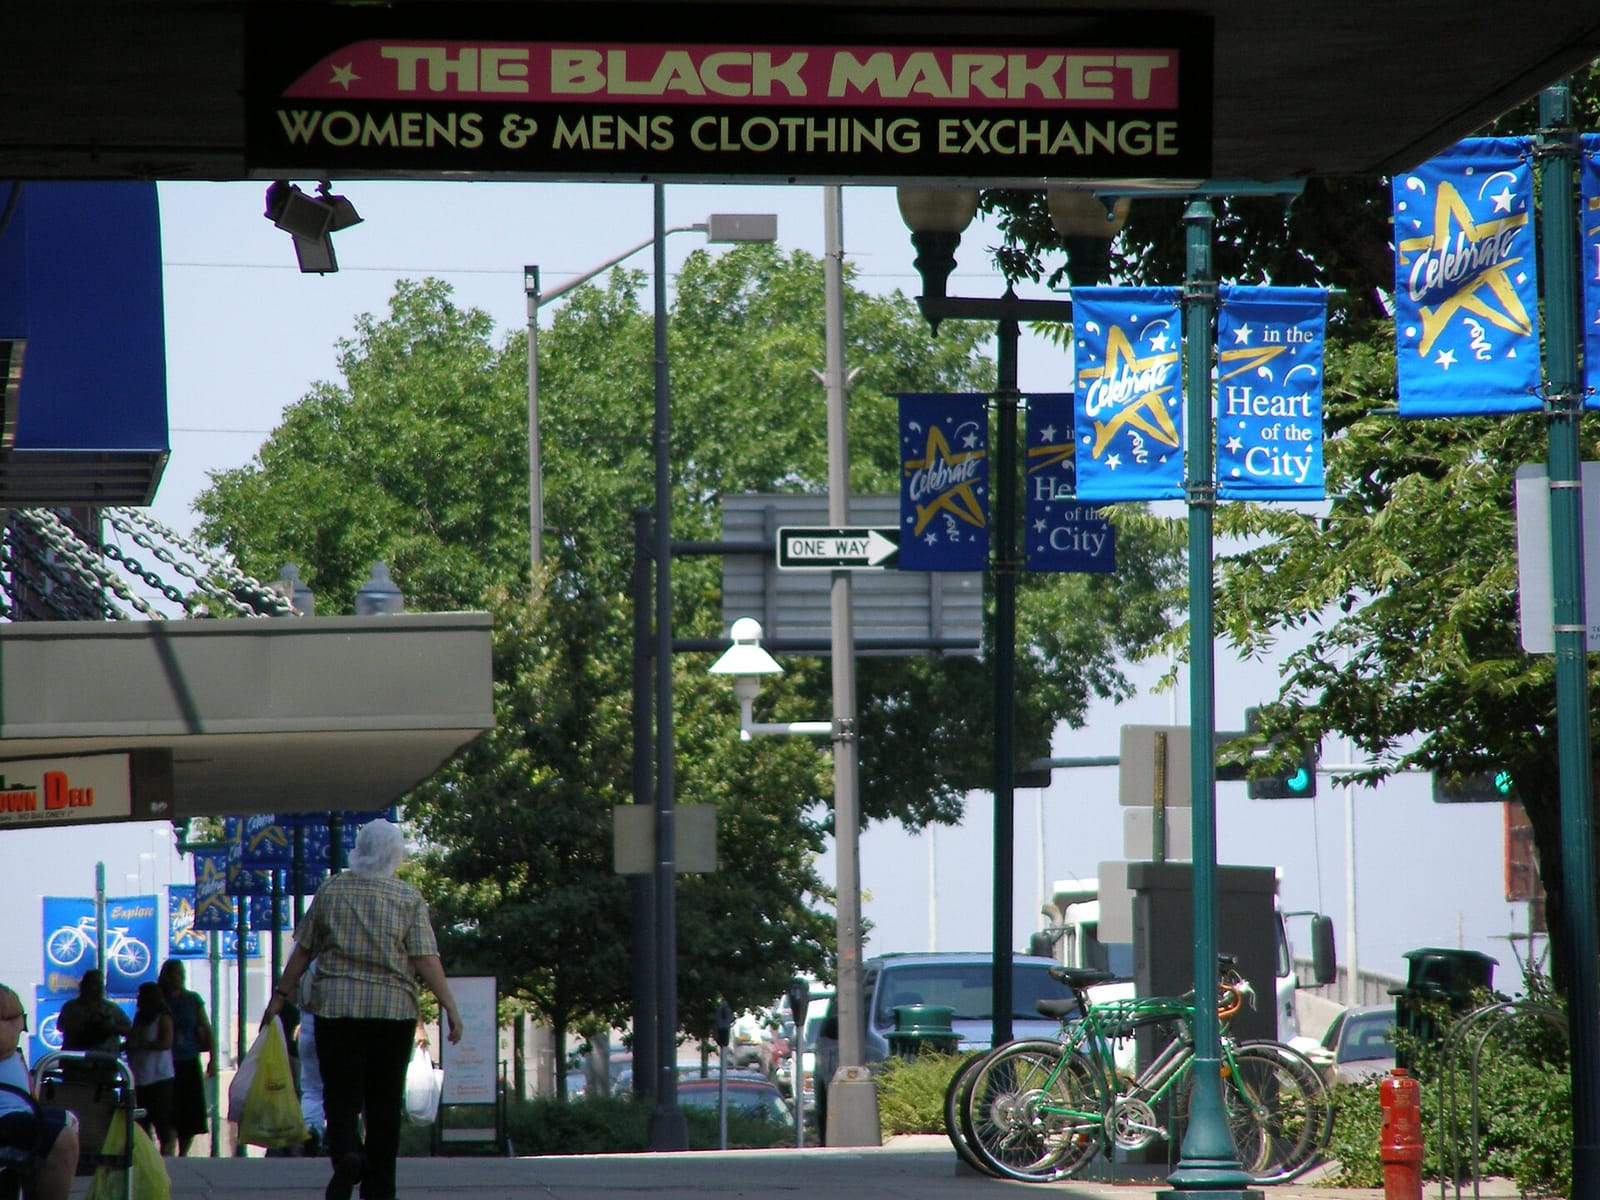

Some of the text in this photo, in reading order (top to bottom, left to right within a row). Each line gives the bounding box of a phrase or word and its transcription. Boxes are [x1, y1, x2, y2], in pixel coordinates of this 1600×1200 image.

[381, 46, 1170, 101] THE BLACK MARKET
[277, 110, 1181, 157] WOMENS & MENS CLOTHING EXCHANGE
[1409, 220, 1523, 302] Celebrate
[1263, 324, 1314, 343] in the
[1085, 361, 1174, 418] Celebrate
[1225, 385, 1313, 418] Heart
[1261, 422, 1313, 442] of the
[908, 452, 983, 501] Celebrate
[1244, 446, 1313, 484] City
[1064, 506, 1082, 521] of
[792, 540, 871, 556] ONE WAY
[1049, 526, 1107, 557] City
